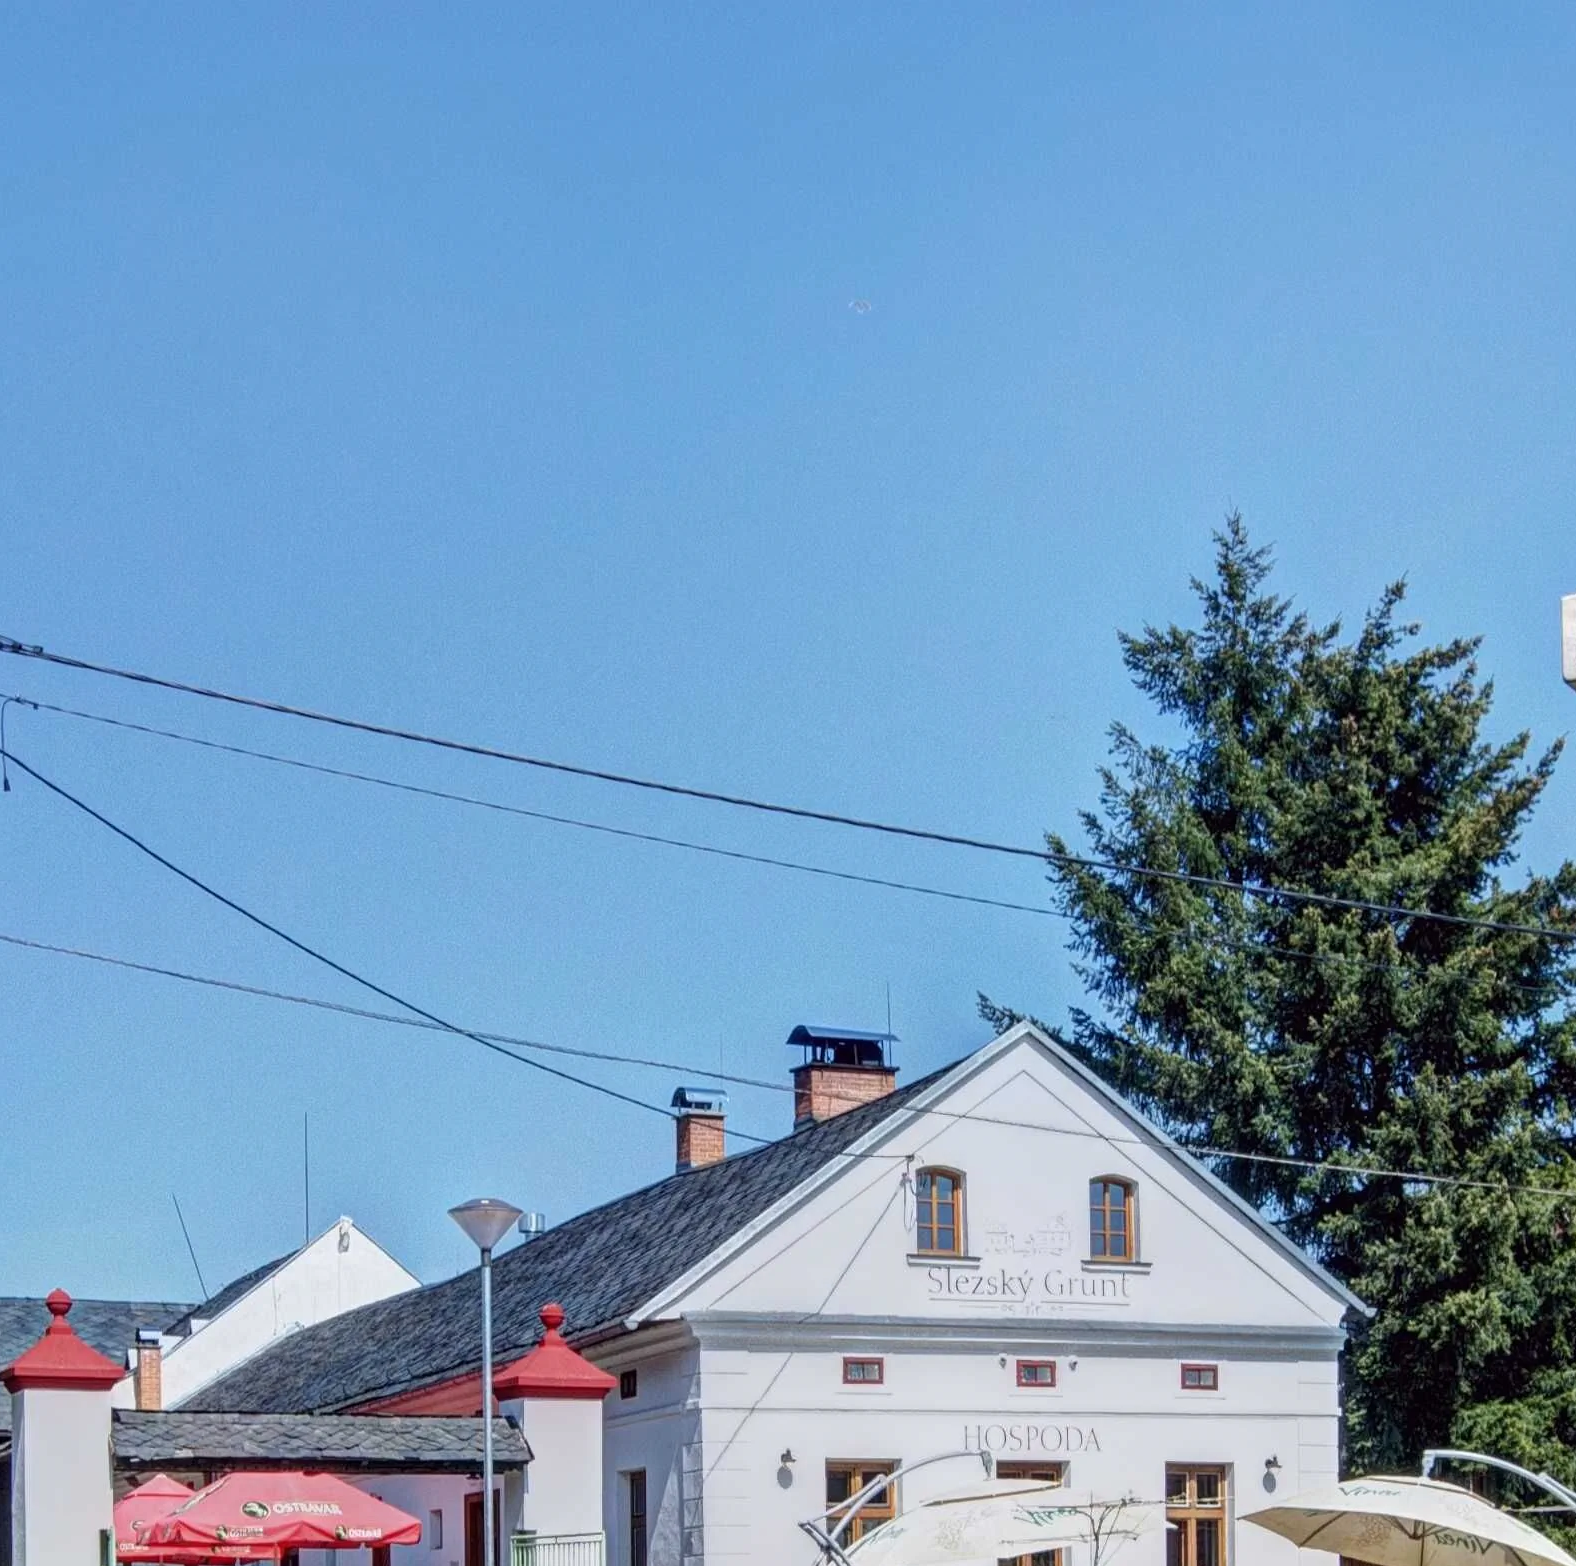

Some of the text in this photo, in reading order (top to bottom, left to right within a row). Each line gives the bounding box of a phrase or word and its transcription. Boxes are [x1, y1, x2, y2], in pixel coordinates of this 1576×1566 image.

[927, 1265, 1132, 1300] Slezský Grunt
[963, 1424, 1102, 1452] HOSPODA
[272, 1502, 343, 1516] OSTRAVAR
